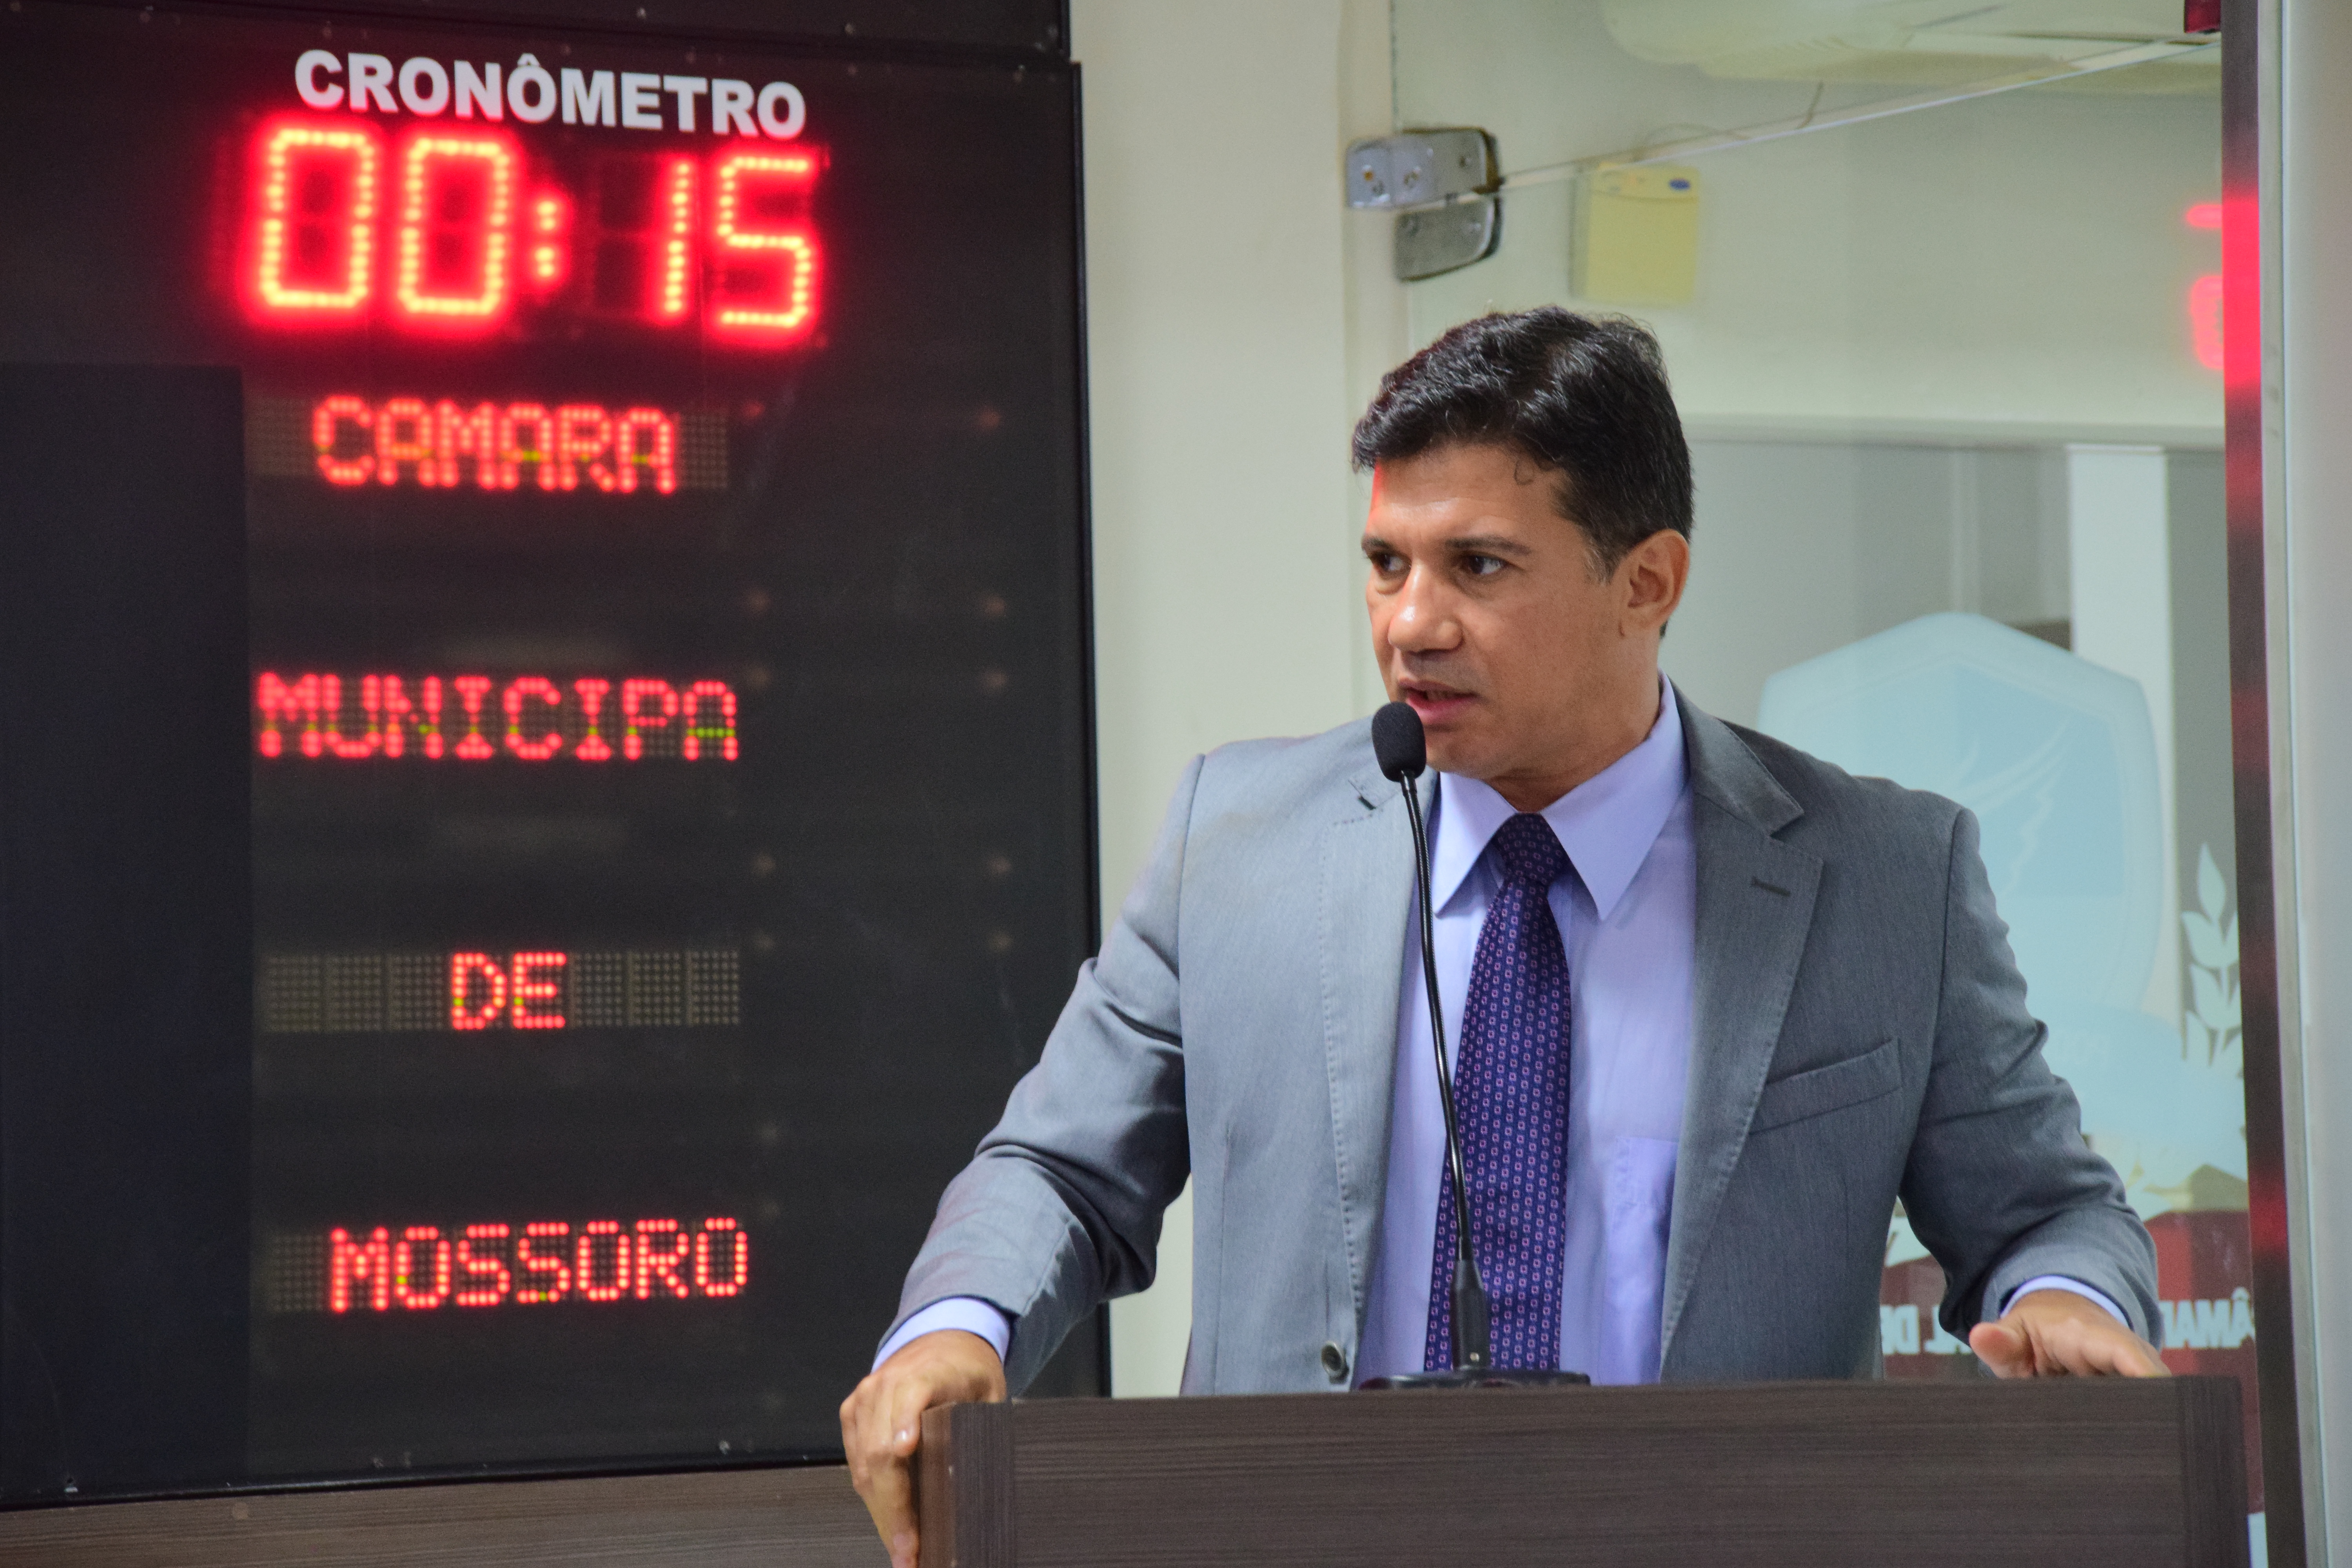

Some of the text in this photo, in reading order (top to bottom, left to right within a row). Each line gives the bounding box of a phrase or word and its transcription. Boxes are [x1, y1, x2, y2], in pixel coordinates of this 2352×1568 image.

[295, 50, 807, 138] CRONÔMETRO
[252, 123, 818, 333] 00:15
[314, 396, 675, 492] CAMARA
[259, 673, 737, 759] MUNICIPA
[452, 953, 566, 1029] DE
[332, 1218, 747, 1312] MOSSORO
